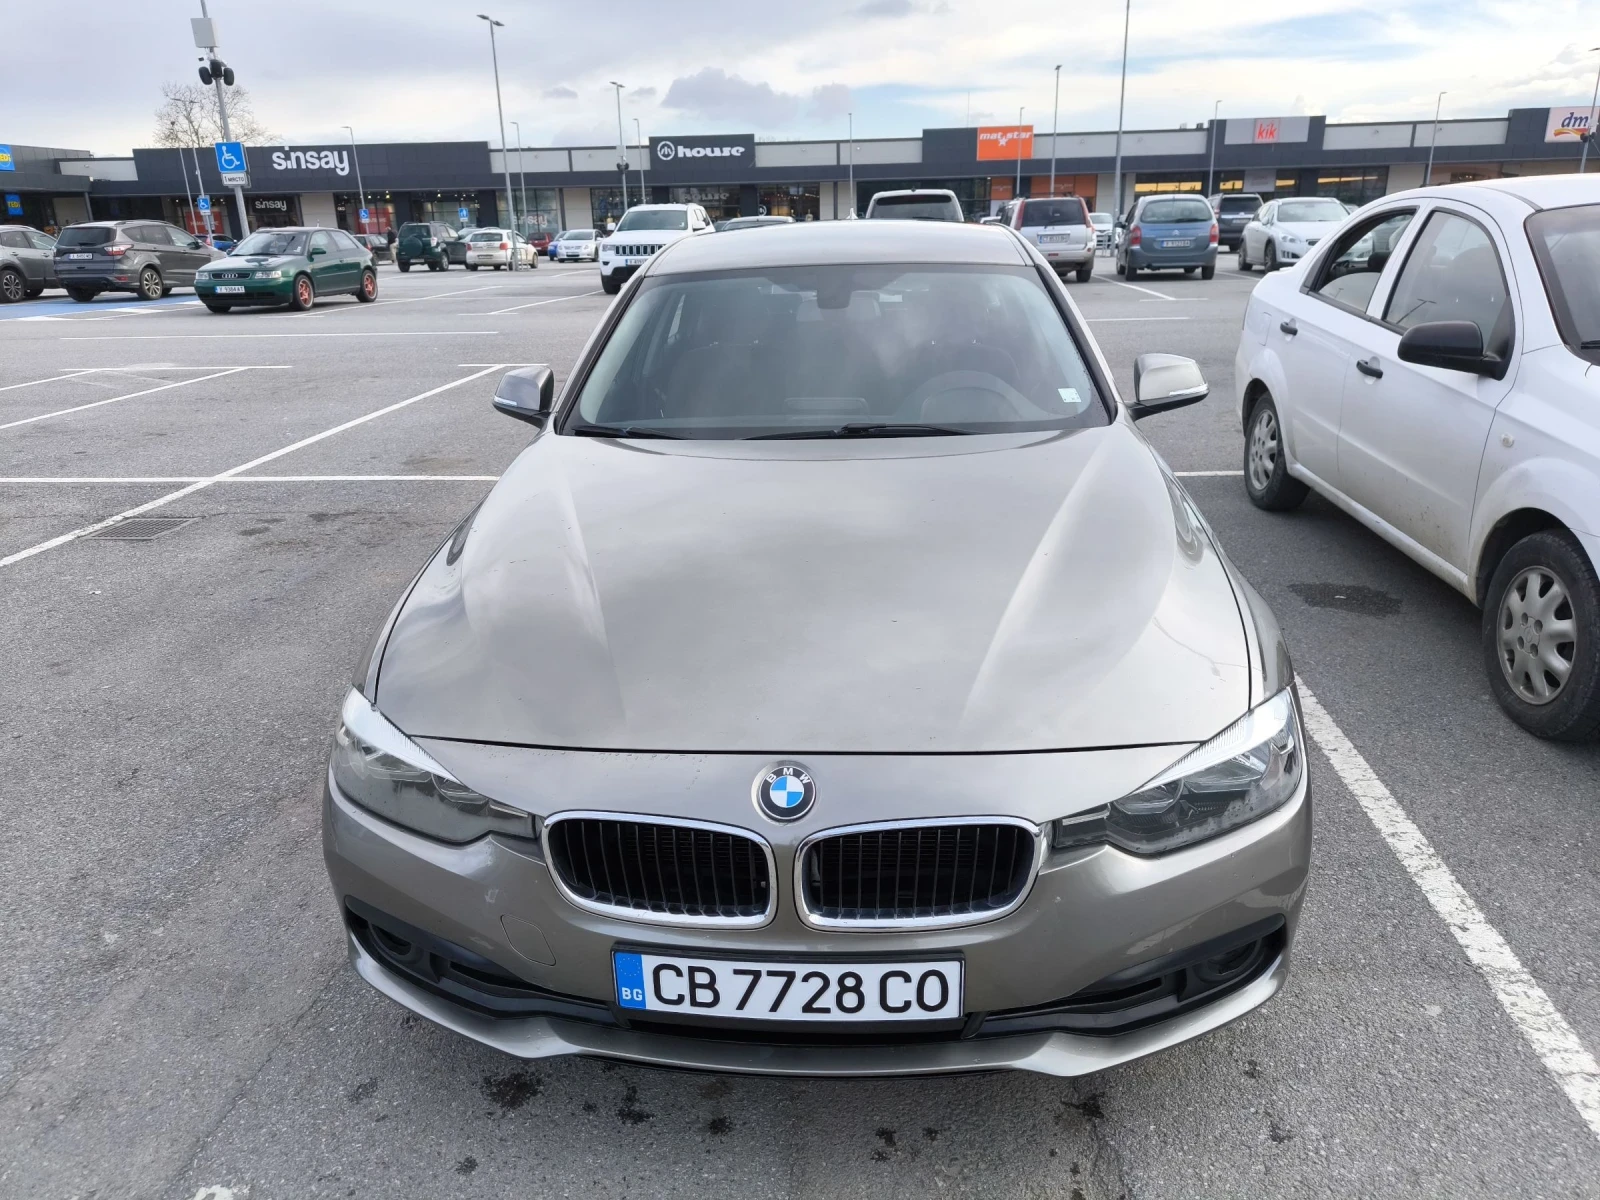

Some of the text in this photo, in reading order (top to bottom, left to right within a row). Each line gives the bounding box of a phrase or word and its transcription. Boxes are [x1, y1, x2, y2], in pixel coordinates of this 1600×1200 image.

[1561, 112, 1589, 128] dm
[979, 131, 1033, 140] mat star
[1257, 123, 1277, 140] kik
[677, 145, 745, 158] house
[272, 146, 350, 176] sinsay
[255, 199, 287, 211] sinsay
[766, 767, 811, 784] BMW
[622, 986, 644, 1001] BG
[653, 963, 950, 1014] CB 7728 CO
